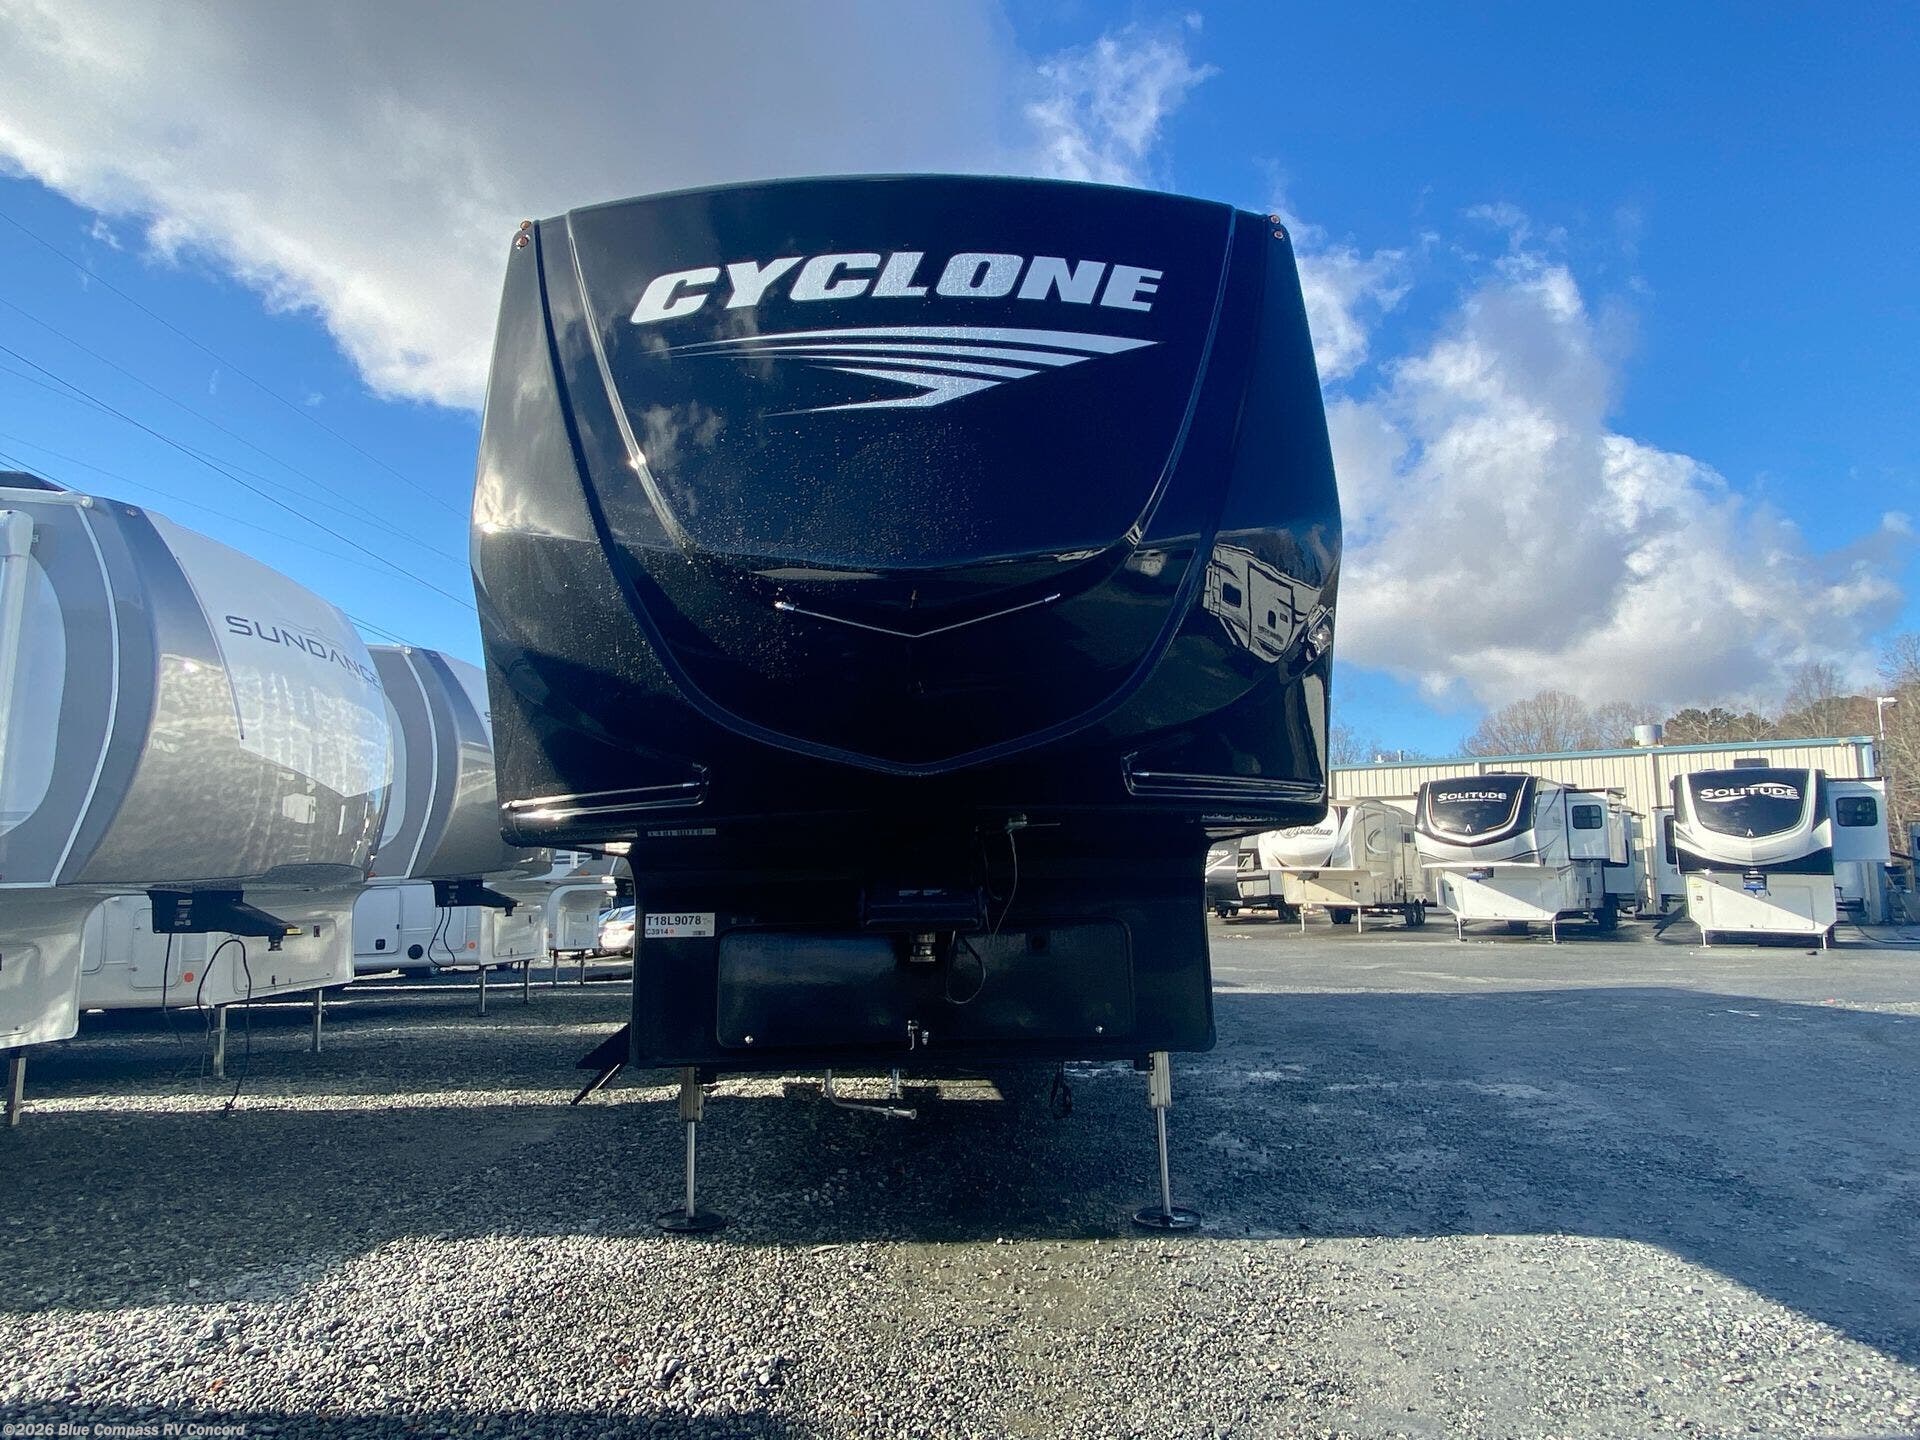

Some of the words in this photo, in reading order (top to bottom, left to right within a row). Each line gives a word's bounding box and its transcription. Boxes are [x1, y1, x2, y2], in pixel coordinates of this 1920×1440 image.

[630, 251, 1163, 324] CYCLONE
[1437, 791, 1507, 801] SOLITUDE
[1700, 787, 1798, 799] SOLITUDE
[646, 915, 702, 926] T18L9078
